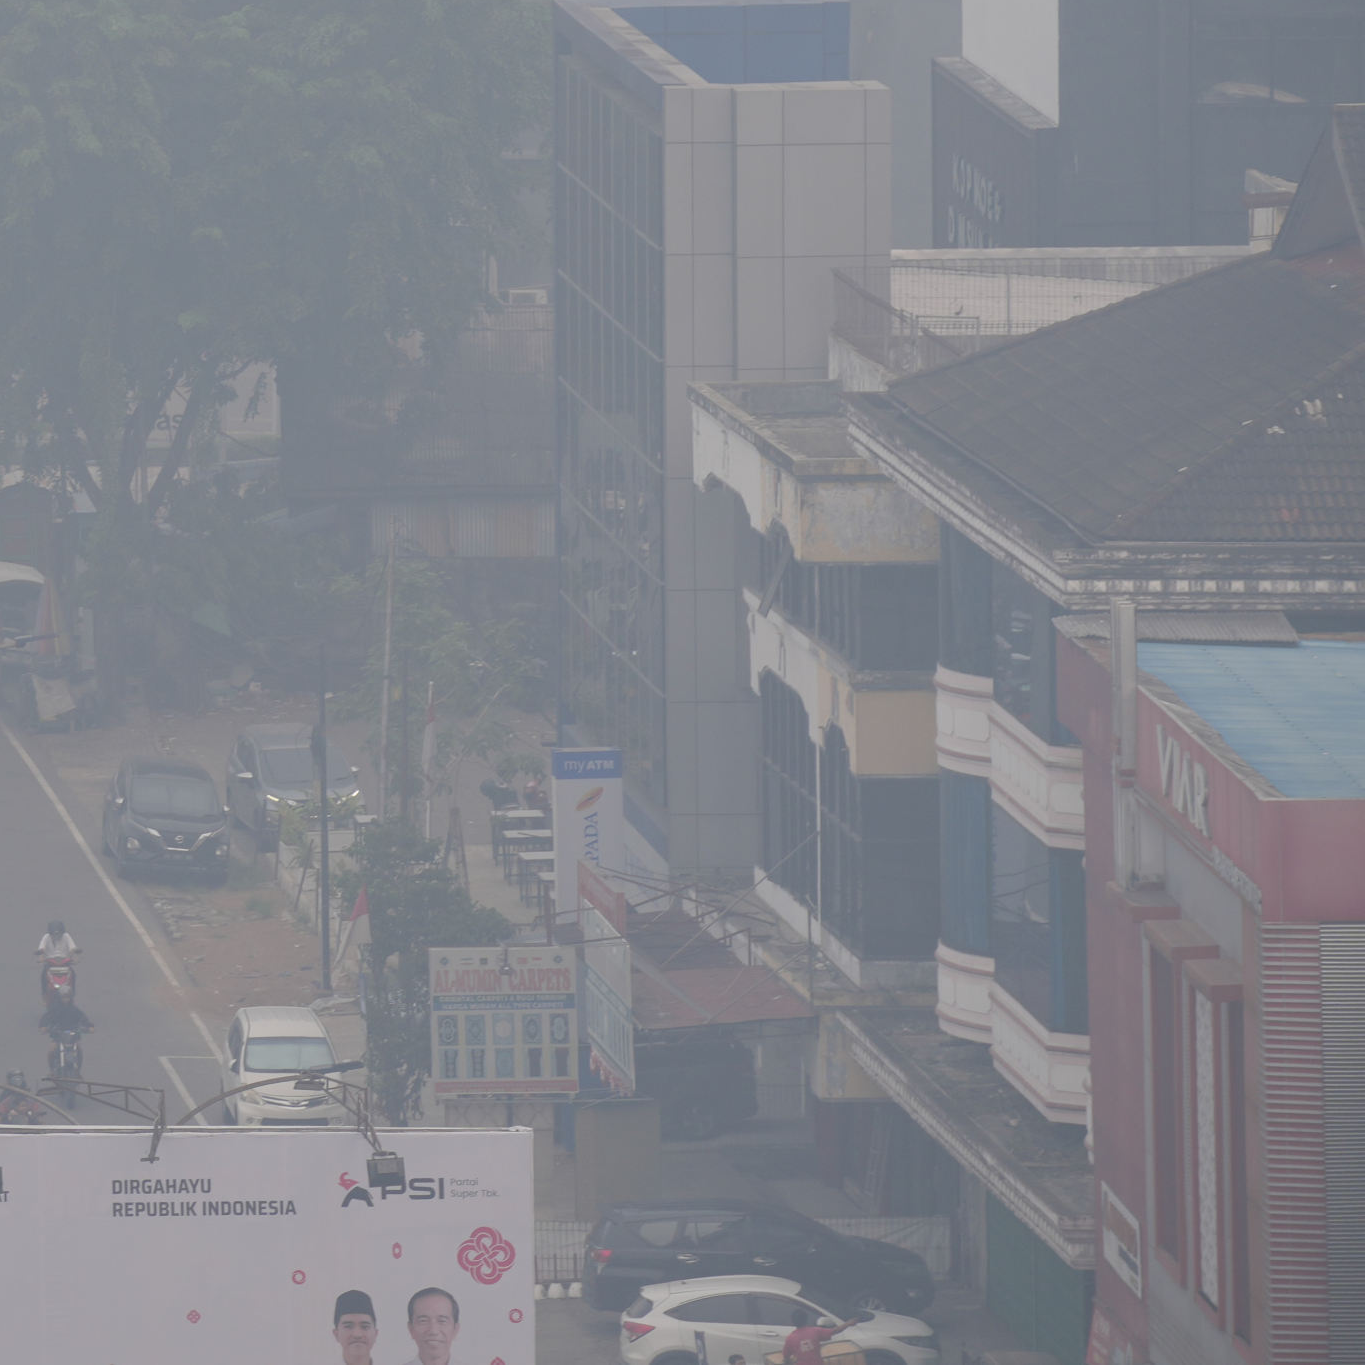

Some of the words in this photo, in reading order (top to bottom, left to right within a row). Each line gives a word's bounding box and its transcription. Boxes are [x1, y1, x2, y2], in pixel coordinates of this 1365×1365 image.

[584, 811, 599, 861] PADA
[508, 968, 570, 992] CARPETS
[111, 1178, 212, 1195] DIRGAHAYU
[449, 1177, 479, 1186] Partai
[449, 1190, 479, 1199] Super
[481, 1189, 501, 1198] Tbk.
[111, 1201, 198, 1217] REPUBLIK
[202, 1200, 297, 1216] INDONESIA
